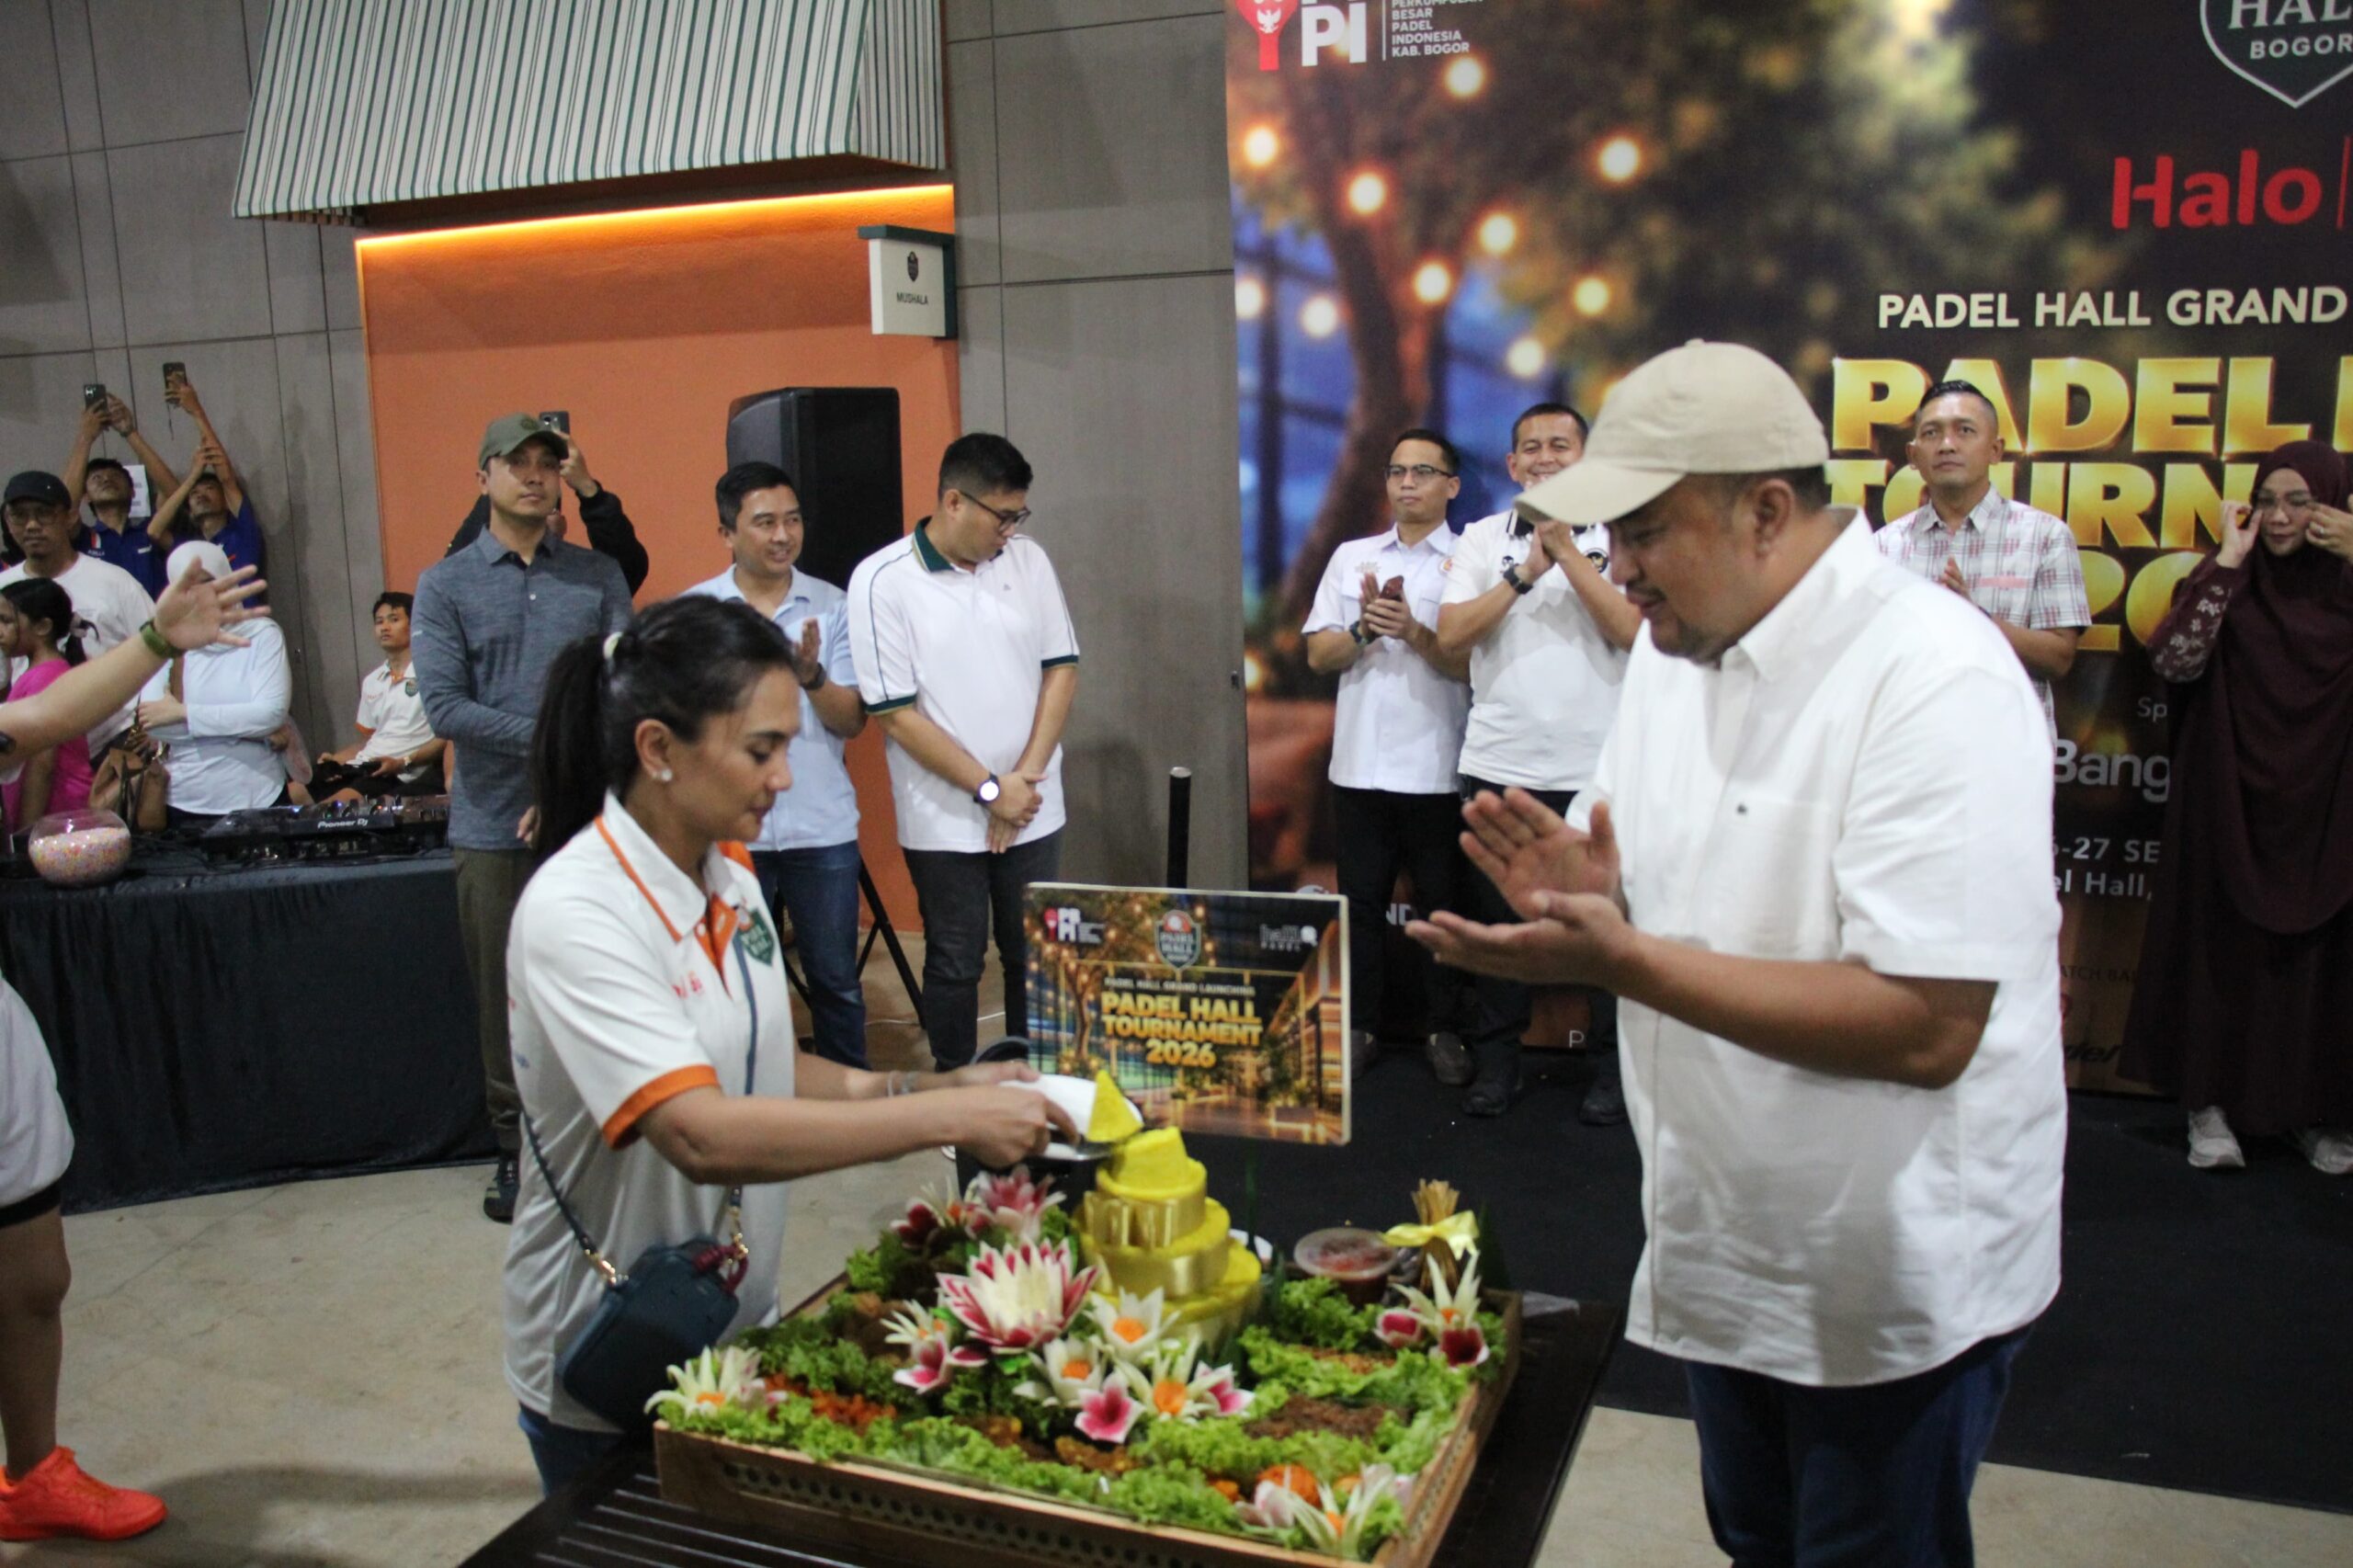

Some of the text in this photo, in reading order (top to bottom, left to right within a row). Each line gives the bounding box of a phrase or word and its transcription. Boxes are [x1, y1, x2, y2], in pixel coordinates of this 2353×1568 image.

[1392, 7, 1433, 20] BESAR
[1392, 20, 1433, 32] PADEL
[1392, 30, 1461, 45] INDONESIA
[1392, 42, 1470, 57] KAB. BOGOR
[2250, 33, 2353, 60] BOGOR
[2112, 149, 2323, 229] Halo
[1878, 287, 2347, 328] PADEL HALL GRAND
[1832, 357, 2312, 454] PADEL
[1101, 991, 1262, 1025] PADEL HALL
[1101, 1014, 1264, 1047] TOURNAMENT
[1145, 1038, 1218, 1069] 2026
